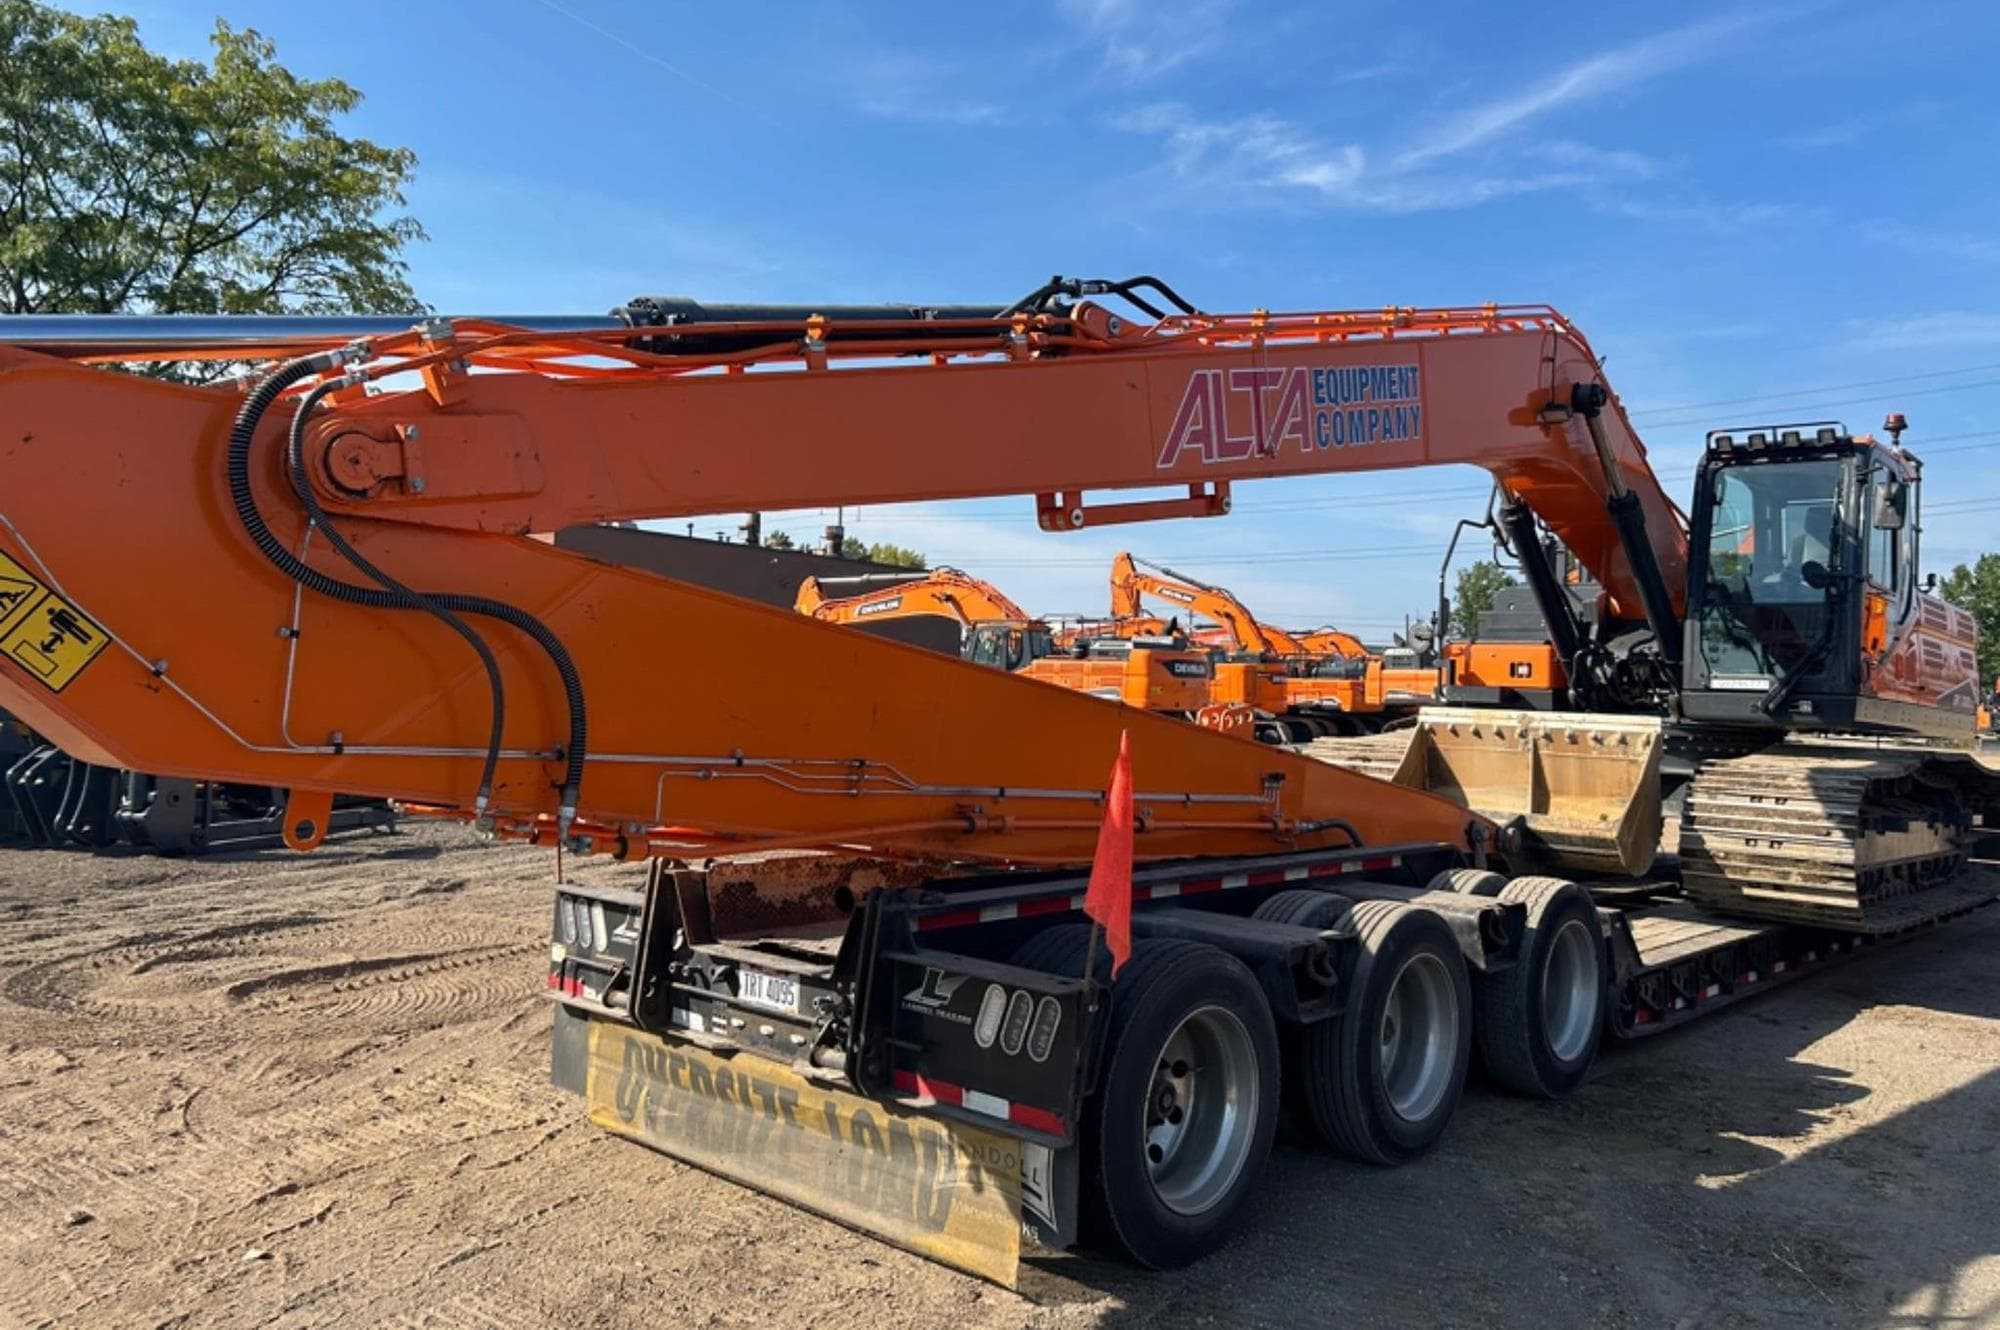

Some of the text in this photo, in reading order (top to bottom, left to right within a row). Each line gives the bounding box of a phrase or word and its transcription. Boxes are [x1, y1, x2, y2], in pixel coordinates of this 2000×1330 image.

[1312, 365, 1419, 405] EQUIPMENT
[1156, 367, 1312, 468] ALTA
[1315, 404, 1421, 449] COMPANY
